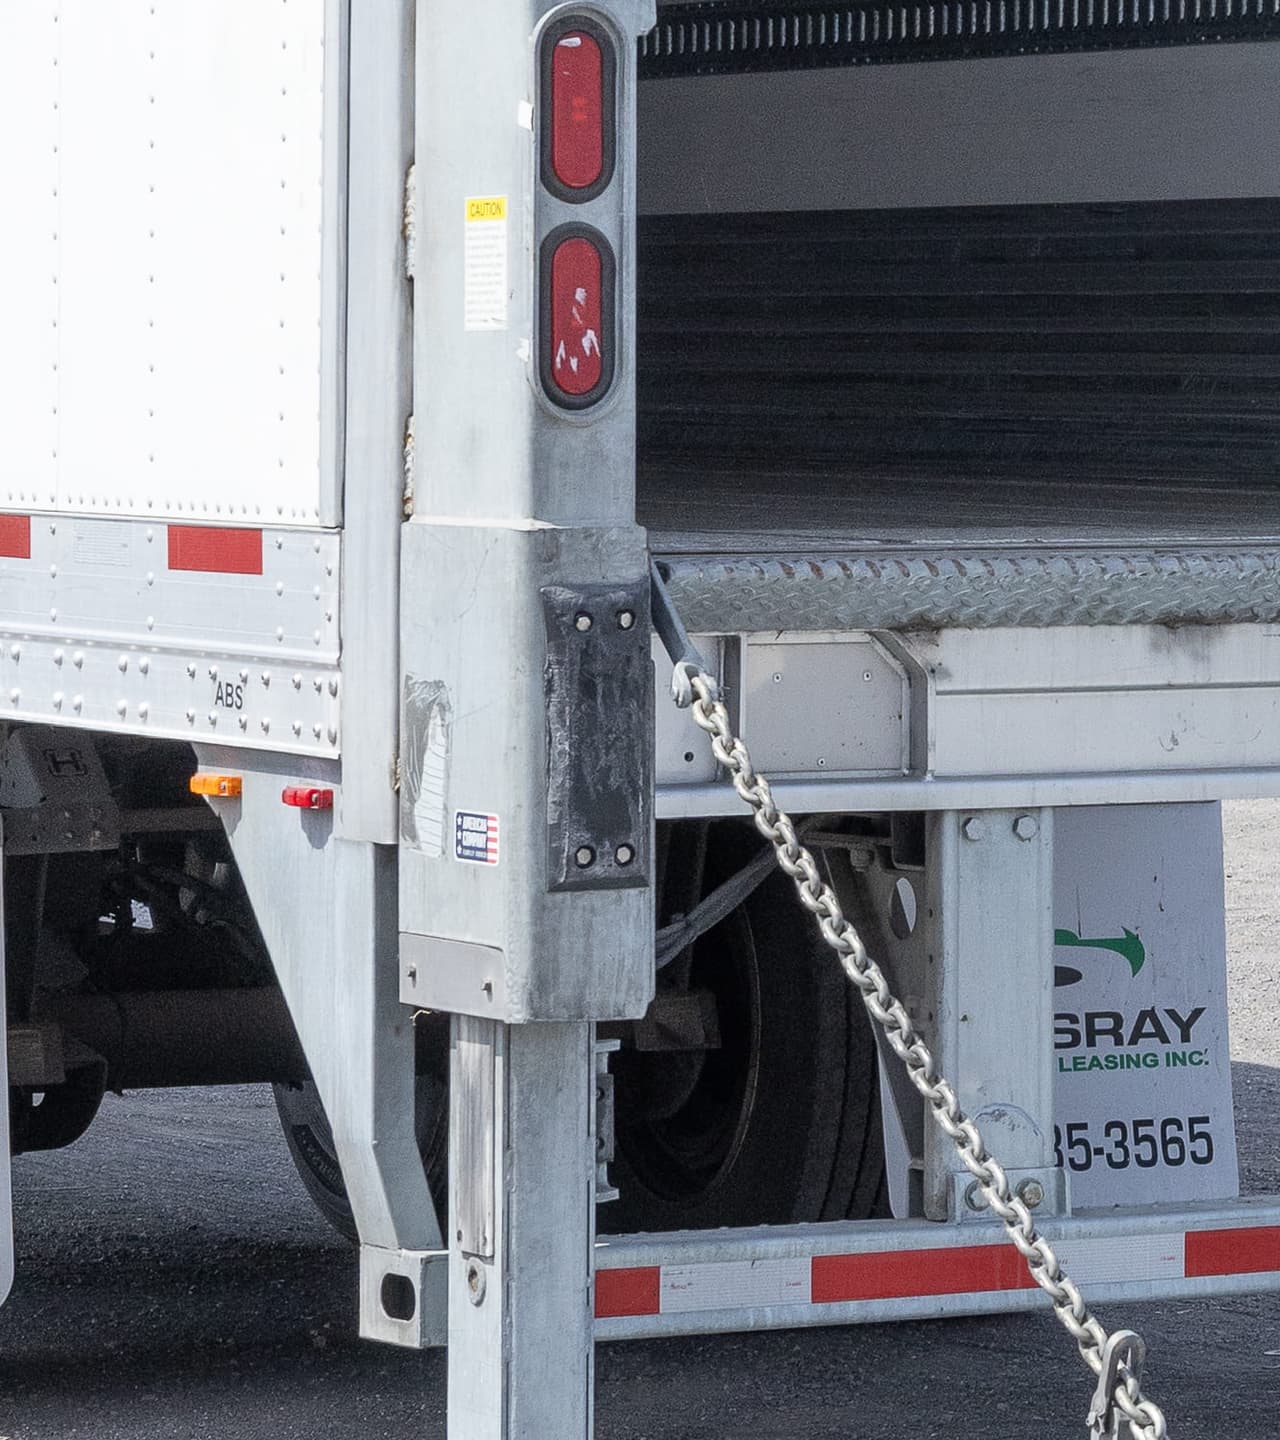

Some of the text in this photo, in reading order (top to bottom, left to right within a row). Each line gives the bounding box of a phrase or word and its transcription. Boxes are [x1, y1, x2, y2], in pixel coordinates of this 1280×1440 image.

[470, 201, 502, 218] CAUTION
[214, 680, 243, 710] ABS
[1058, 1051, 1159, 1073] LEASING
